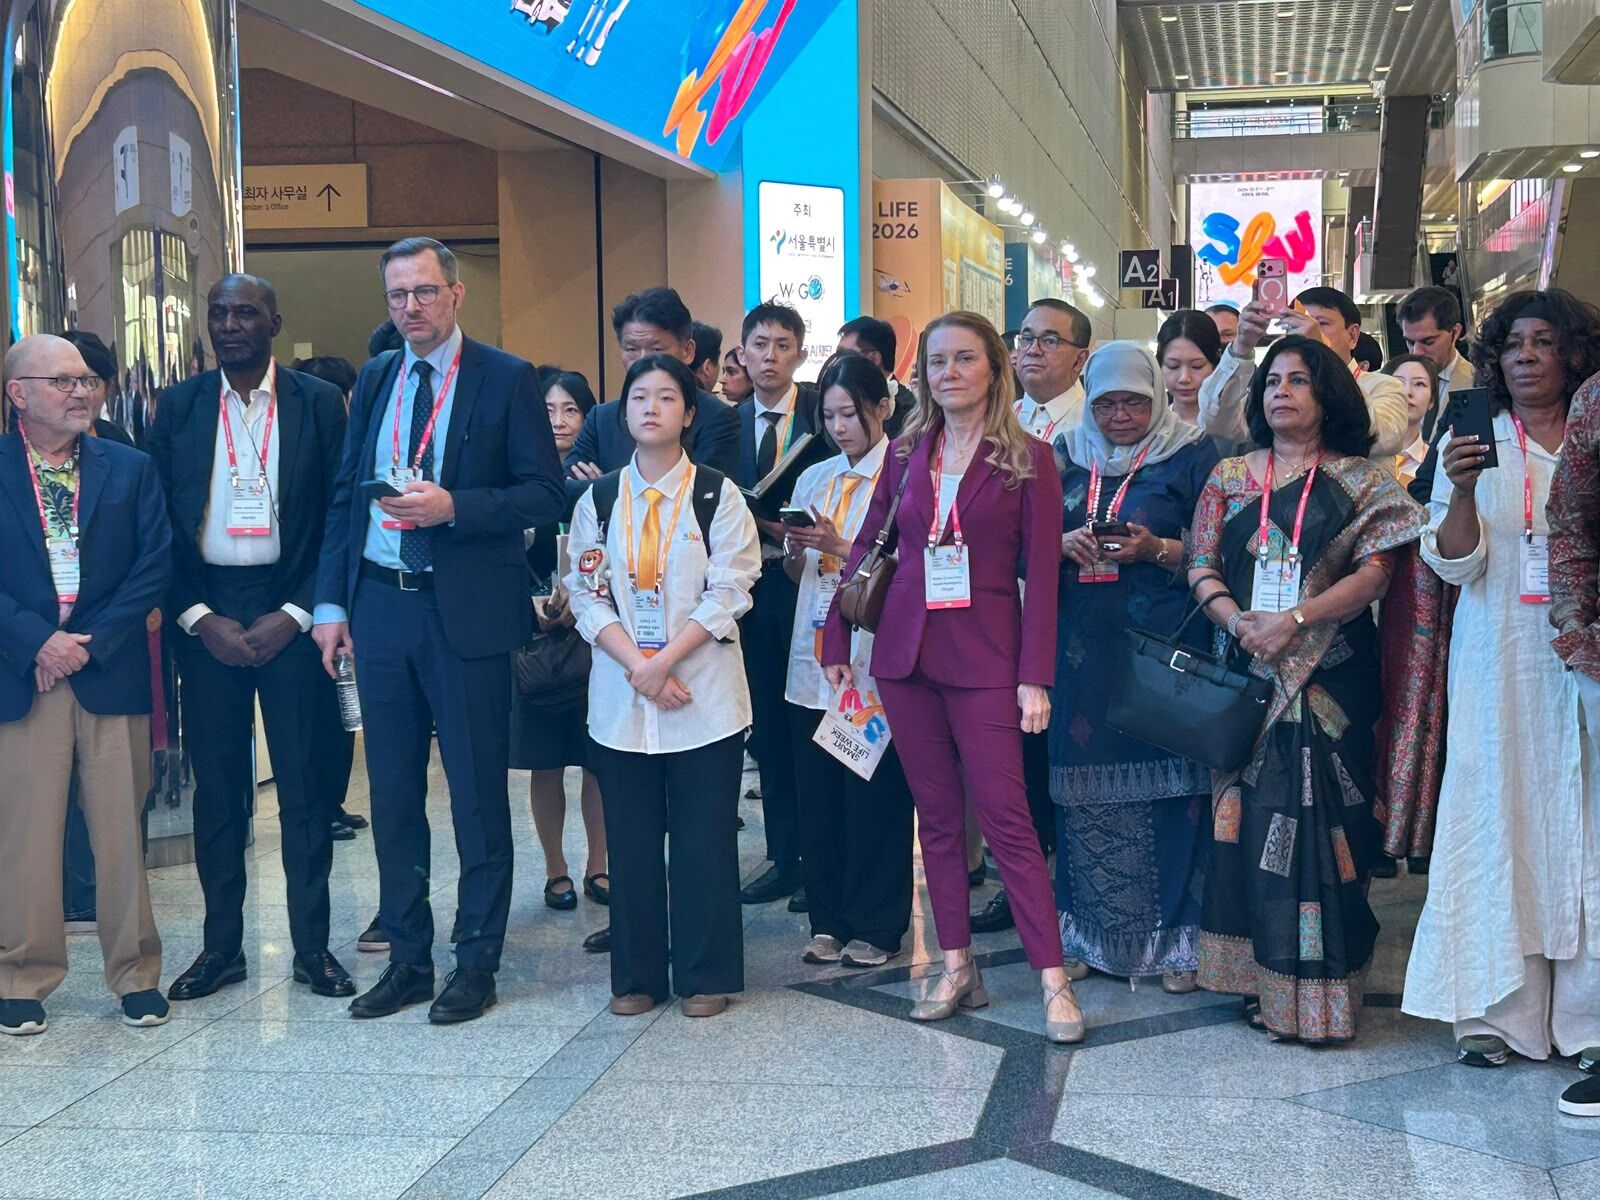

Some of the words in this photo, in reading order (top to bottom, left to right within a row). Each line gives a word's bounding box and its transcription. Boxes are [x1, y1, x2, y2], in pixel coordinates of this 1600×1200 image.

[271, 185, 307, 200] 사무실
[793, 203, 812, 218] 주최
[878, 202, 918, 218] LIFE
[872, 223, 919, 239] 2026
[788, 233, 835, 253] 서울특별시
[1123, 255, 1159, 283] A2
[1147, 289, 1175, 307] A1
[830, 726, 854, 747] WEEK
[833, 739, 861, 761] SMART
[853, 744, 870, 760] LIFE
